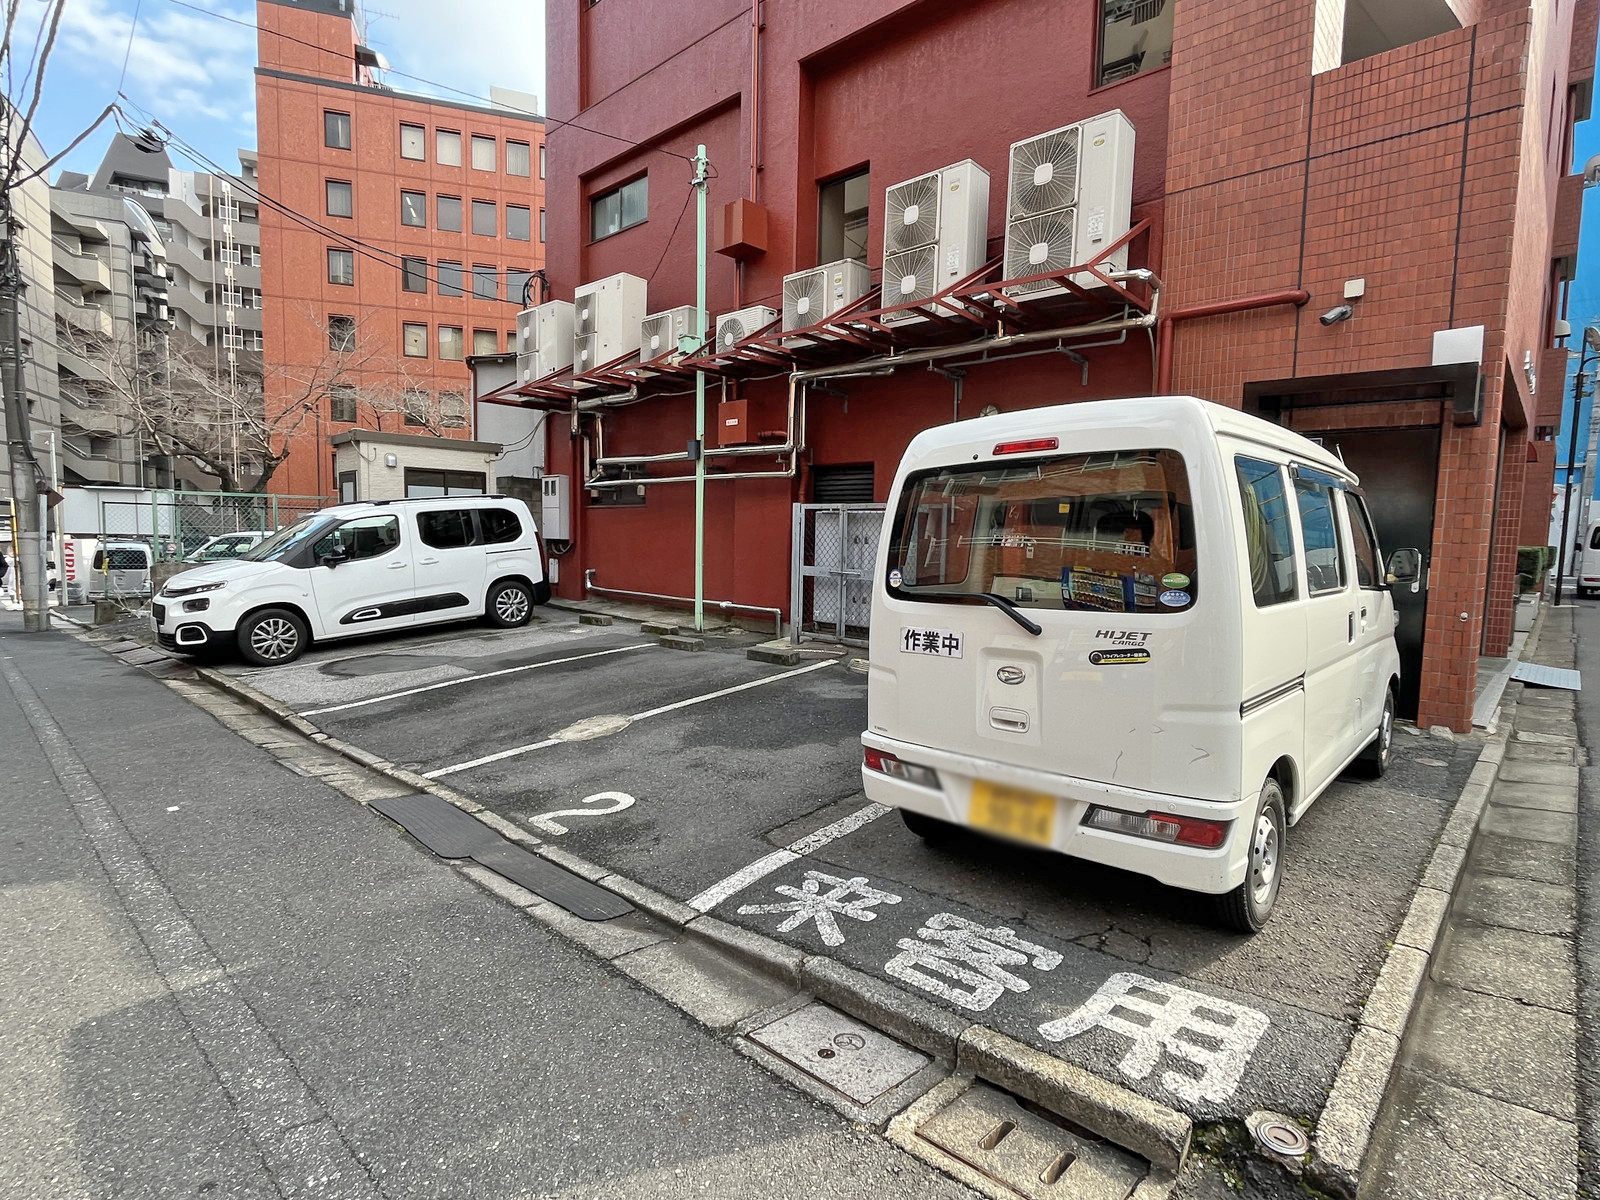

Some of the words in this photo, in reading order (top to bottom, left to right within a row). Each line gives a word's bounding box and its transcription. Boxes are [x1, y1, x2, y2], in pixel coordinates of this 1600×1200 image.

[904, 629, 959, 656] 作業中
[1095, 630, 1152, 641] HIJET
[529, 791, 635, 835] 2
[737, 870, 1270, 1104] 来客用
